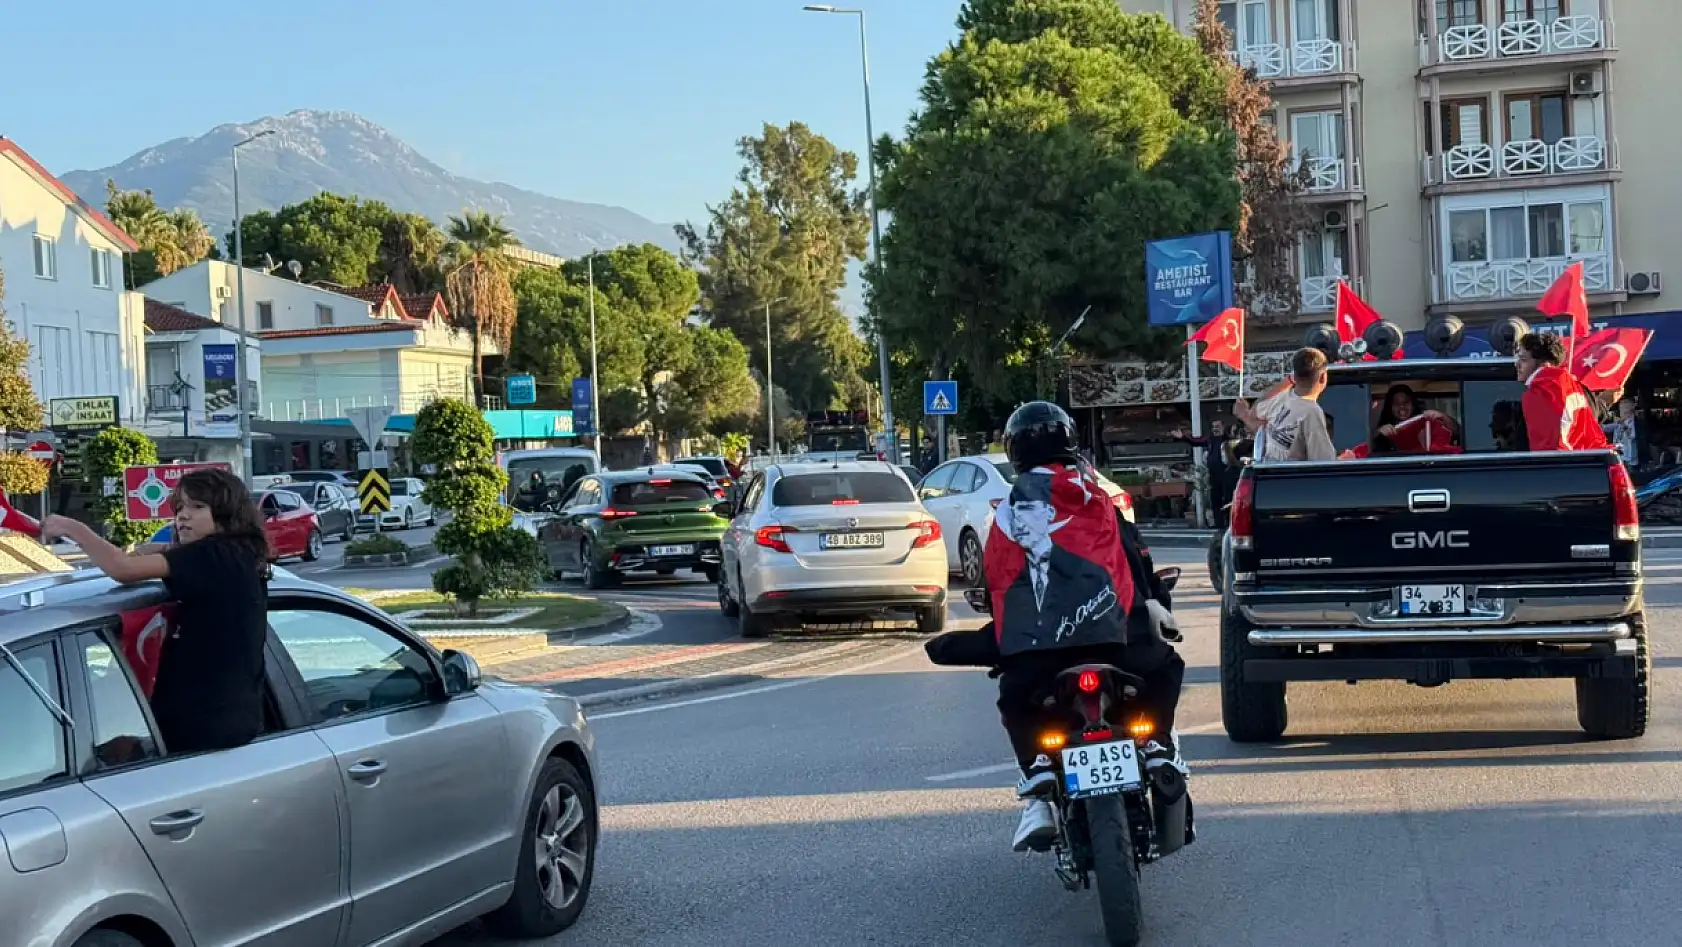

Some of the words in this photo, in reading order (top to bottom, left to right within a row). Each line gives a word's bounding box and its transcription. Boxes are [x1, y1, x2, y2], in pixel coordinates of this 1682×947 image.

[1157, 264, 1208, 281] AMETIST
[1154, 276, 1211, 291] RESTAURANT
[1174, 288, 1193, 298] BAR
[76, 400, 111, 411] EMLAK
[863, 533, 882, 545] 389
[1391, 530, 1470, 549] GMC
[1260, 557, 1333, 567] SIERRA
[1405, 587, 1421, 599] 34
[1443, 586, 1460, 599] JK
[1068, 750, 1089, 767] 48
[1100, 743, 1132, 763] ASC
[1090, 765, 1124, 784] 552
